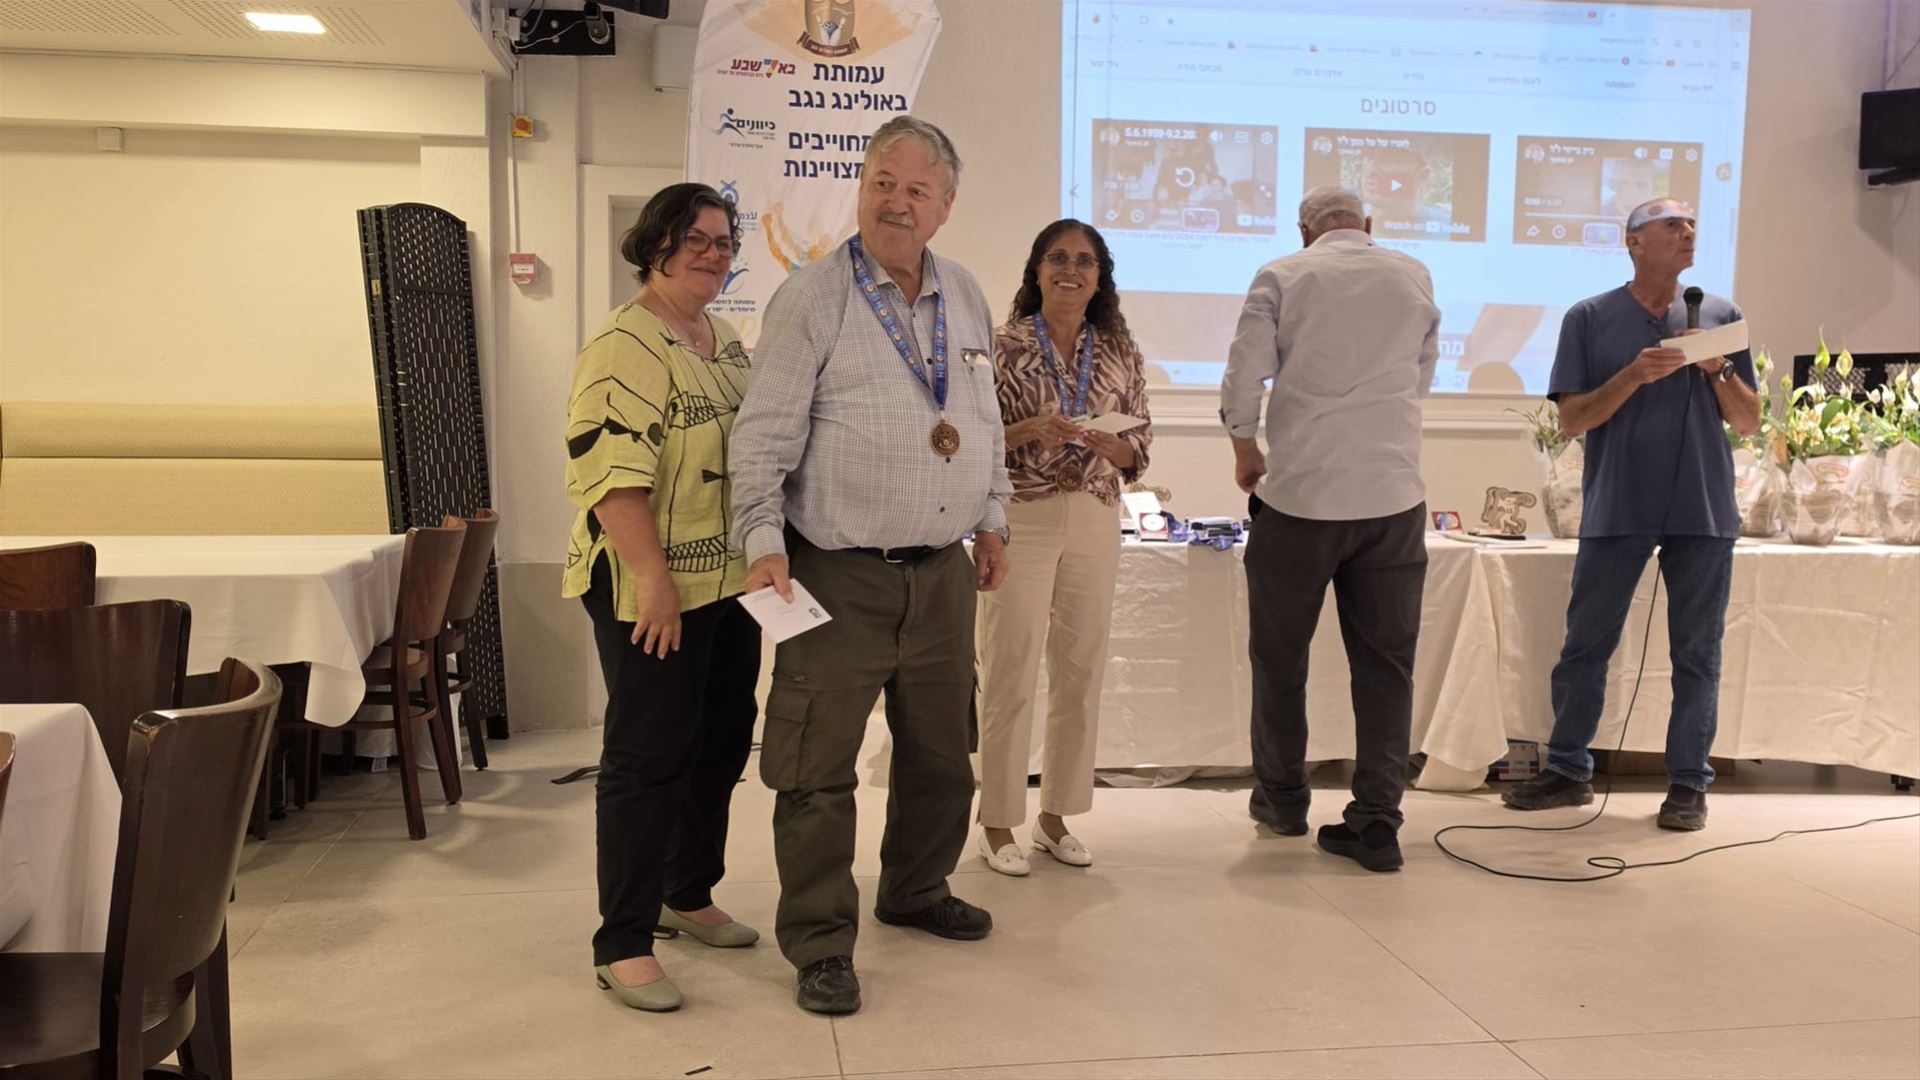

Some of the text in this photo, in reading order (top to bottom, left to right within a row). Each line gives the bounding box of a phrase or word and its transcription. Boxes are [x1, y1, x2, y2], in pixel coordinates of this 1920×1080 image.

[731, 59, 763, 72] שבע
[813, 63, 885, 84] עמותת
[788, 89, 908, 111] באולינג נגב
[1361, 98, 1436, 115] סרטונים
[736, 119, 776, 131] כיוונים
